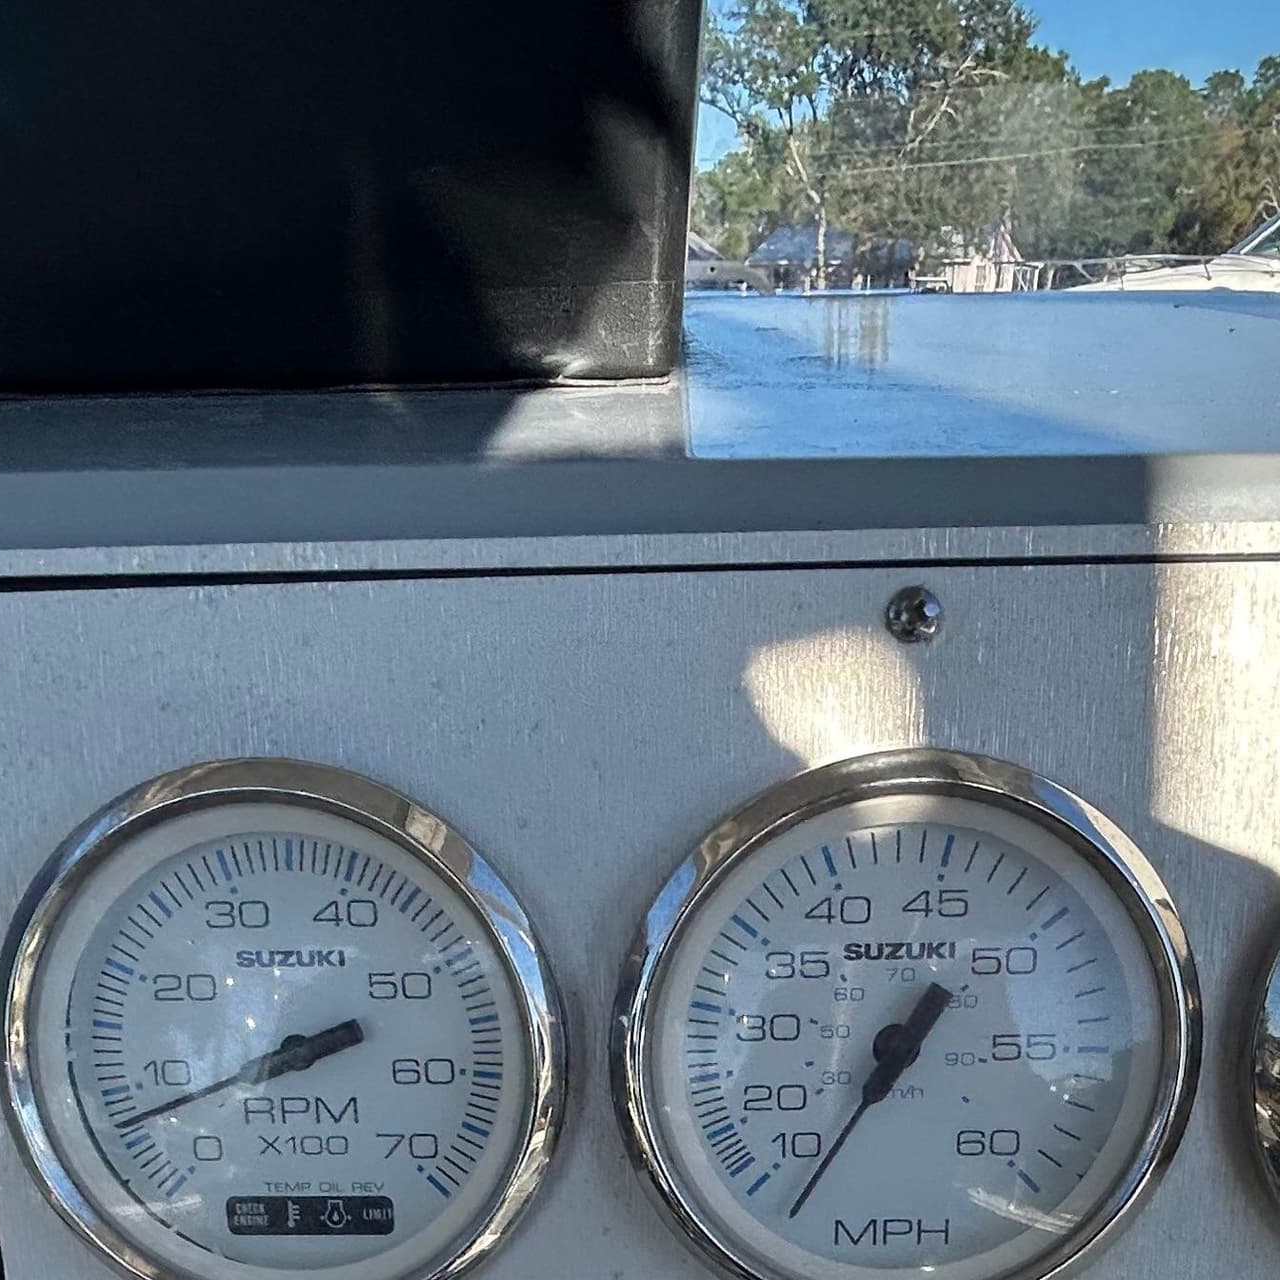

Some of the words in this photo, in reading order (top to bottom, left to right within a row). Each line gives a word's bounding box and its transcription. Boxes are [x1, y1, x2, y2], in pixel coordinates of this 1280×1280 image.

[205, 901, 270, 929] 30
[312, 900, 378, 928] 40
[805, 897, 871, 925] 40
[902, 889, 969, 918] 45
[236, 951, 346, 968] SUZUKI
[765, 951, 830, 980] 35
[843, 942, 956, 961] SUZUKI
[971, 947, 1037, 976] 50
[153, 974, 218, 1002] 20
[368, 972, 432, 1000] 50
[885, 967, 915, 982] 70
[834, 987, 865, 1002] 60
[736, 1013, 800, 1042] 30
[820, 1024, 850, 1039] 50
[944, 1052, 975, 1066] 90
[991, 1034, 1057, 1062] 55
[144, 1059, 192, 1087] 10
[392, 1059, 455, 1085] 60
[822, 1071, 851, 1085] 30
[243, 1096, 360, 1125] RPM
[743, 1084, 807, 1112] 20
[194, 1135, 223, 1162] 0
[259, 1135, 349, 1156] X100
[376, 1132, 439, 1160] 70
[771, 1131, 821, 1159] 10
[956, 1129, 1020, 1157] 60
[264, 1182, 311, 1193] TEMP
[319, 1182, 344, 1193] OIL
[352, 1182, 385, 1193] REV
[362, 1208, 392, 1221] LIMIT
[834, 1218, 950, 1246] MPH
